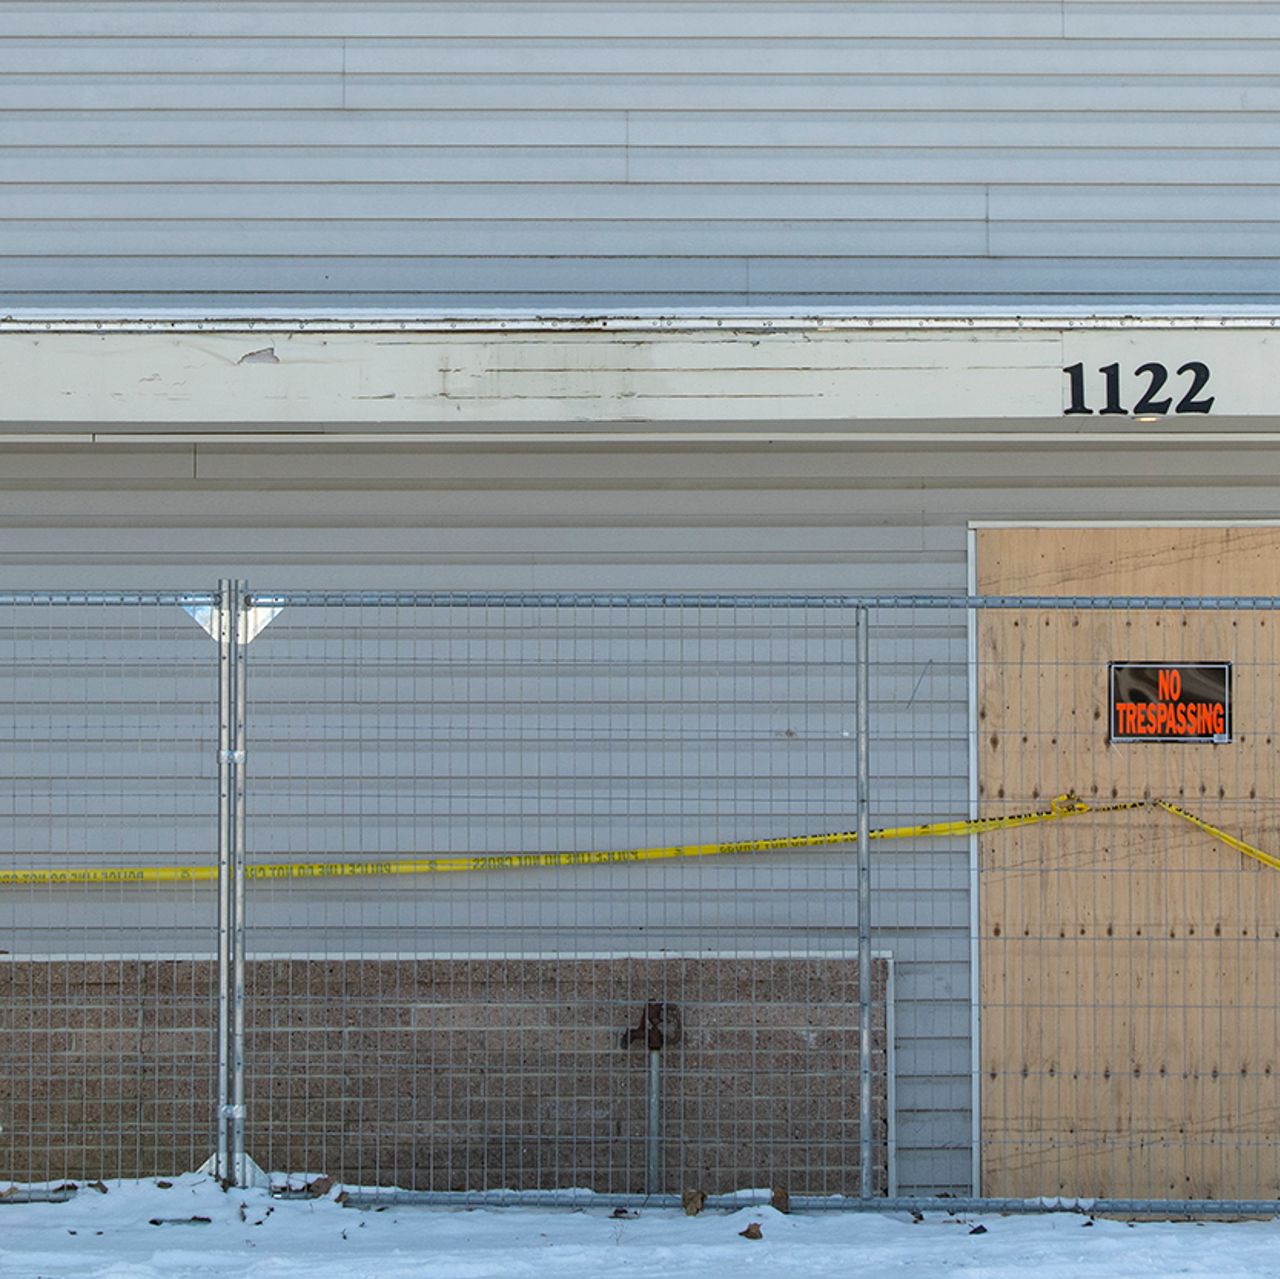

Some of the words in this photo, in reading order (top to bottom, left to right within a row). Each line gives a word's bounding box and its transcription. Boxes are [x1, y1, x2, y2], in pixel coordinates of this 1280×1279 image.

[1062, 361, 1215, 415] 1122
[1158, 669, 1181, 701] NO
[1116, 702, 1225, 735] TRESPASSING
